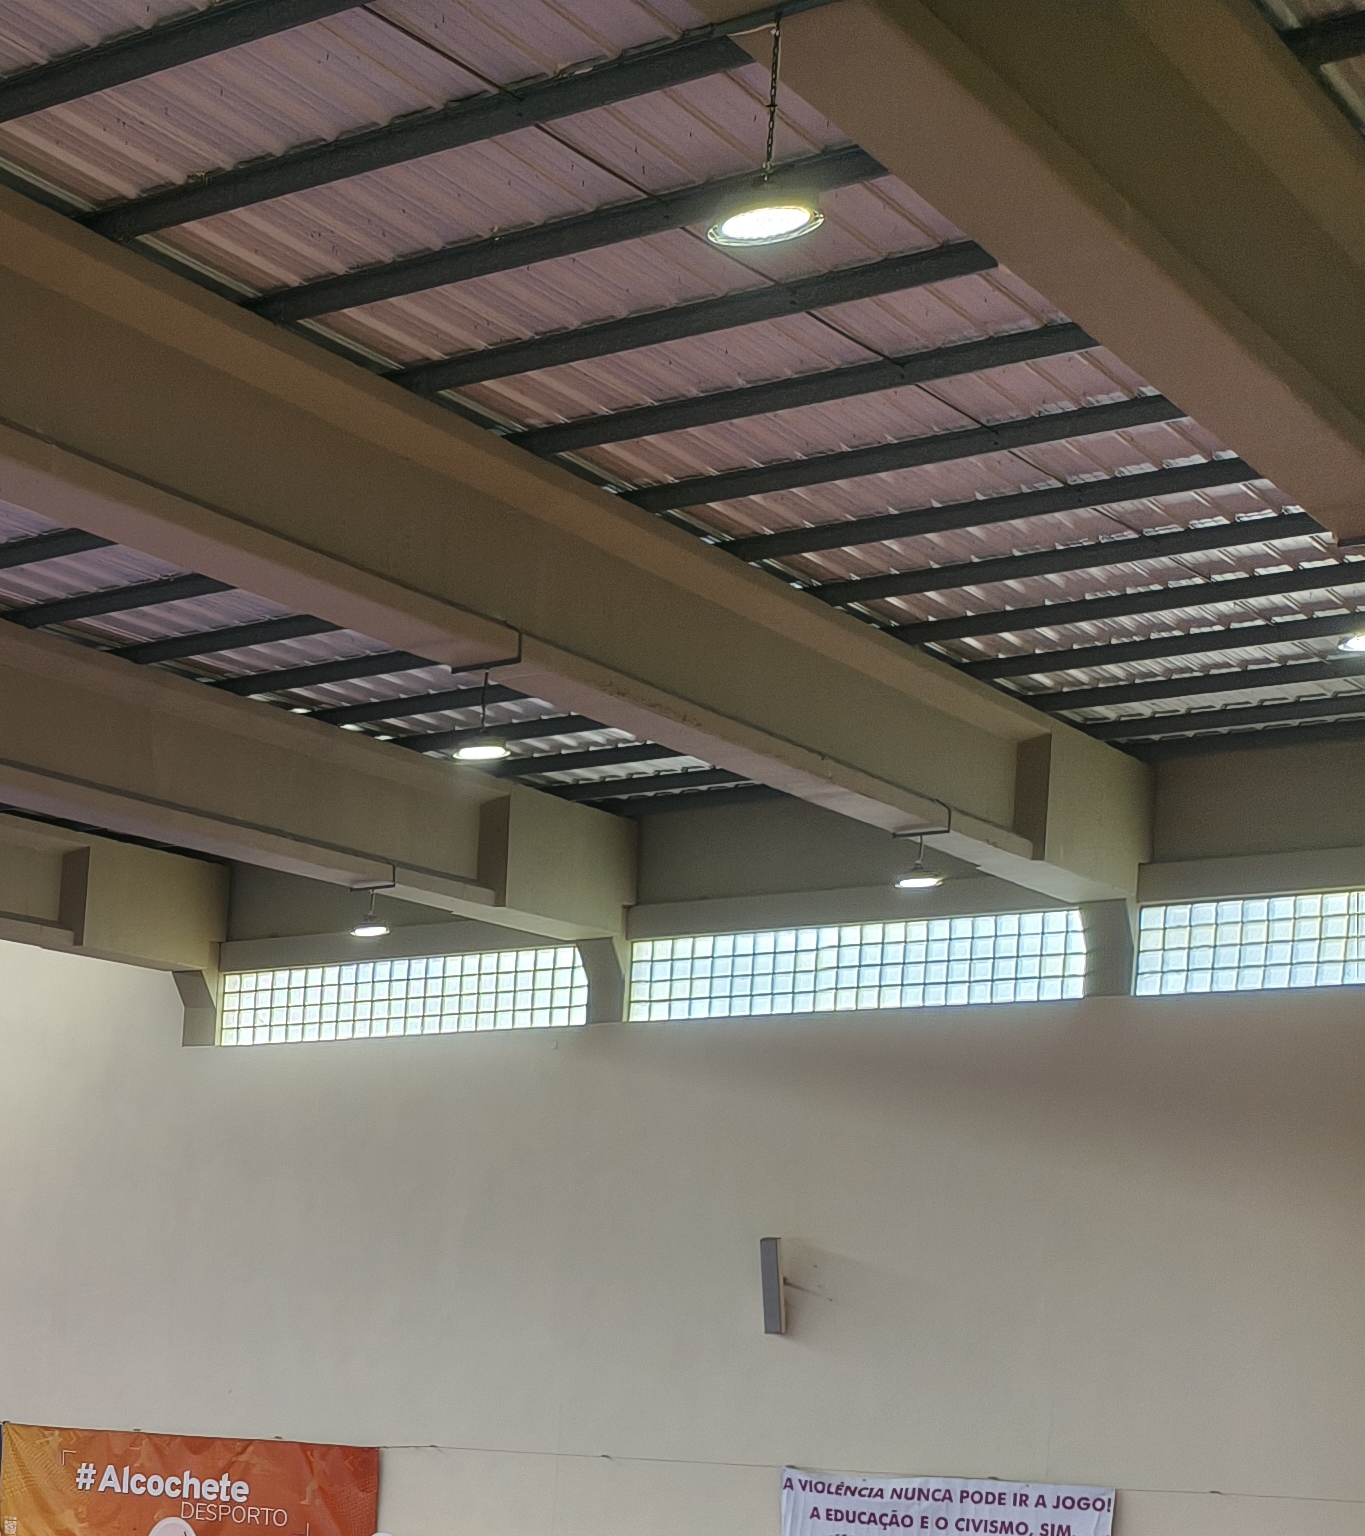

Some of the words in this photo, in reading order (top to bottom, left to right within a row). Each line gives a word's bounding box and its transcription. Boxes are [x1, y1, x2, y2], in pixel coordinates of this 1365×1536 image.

[75, 1462, 250, 1503] #Alcochete
[782, 1477, 794, 1491] A
[798, 1478, 885, 1500] VIOLÊNCIA
[890, 1487, 953, 1504] NUNCA
[959, 1489, 1007, 1506] PODE
[1012, 1492, 1029, 1508] IR
[1034, 1493, 1047, 1509] A
[1051, 1494, 1112, 1513] JOGO!
[180, 1501, 288, 1527] DESPORTO
[809, 1506, 821, 1520] A
[825, 1508, 914, 1531] EDUCAÇÃO
[920, 1515, 929, 1529] E
[934, 1516, 949, 1531] O
